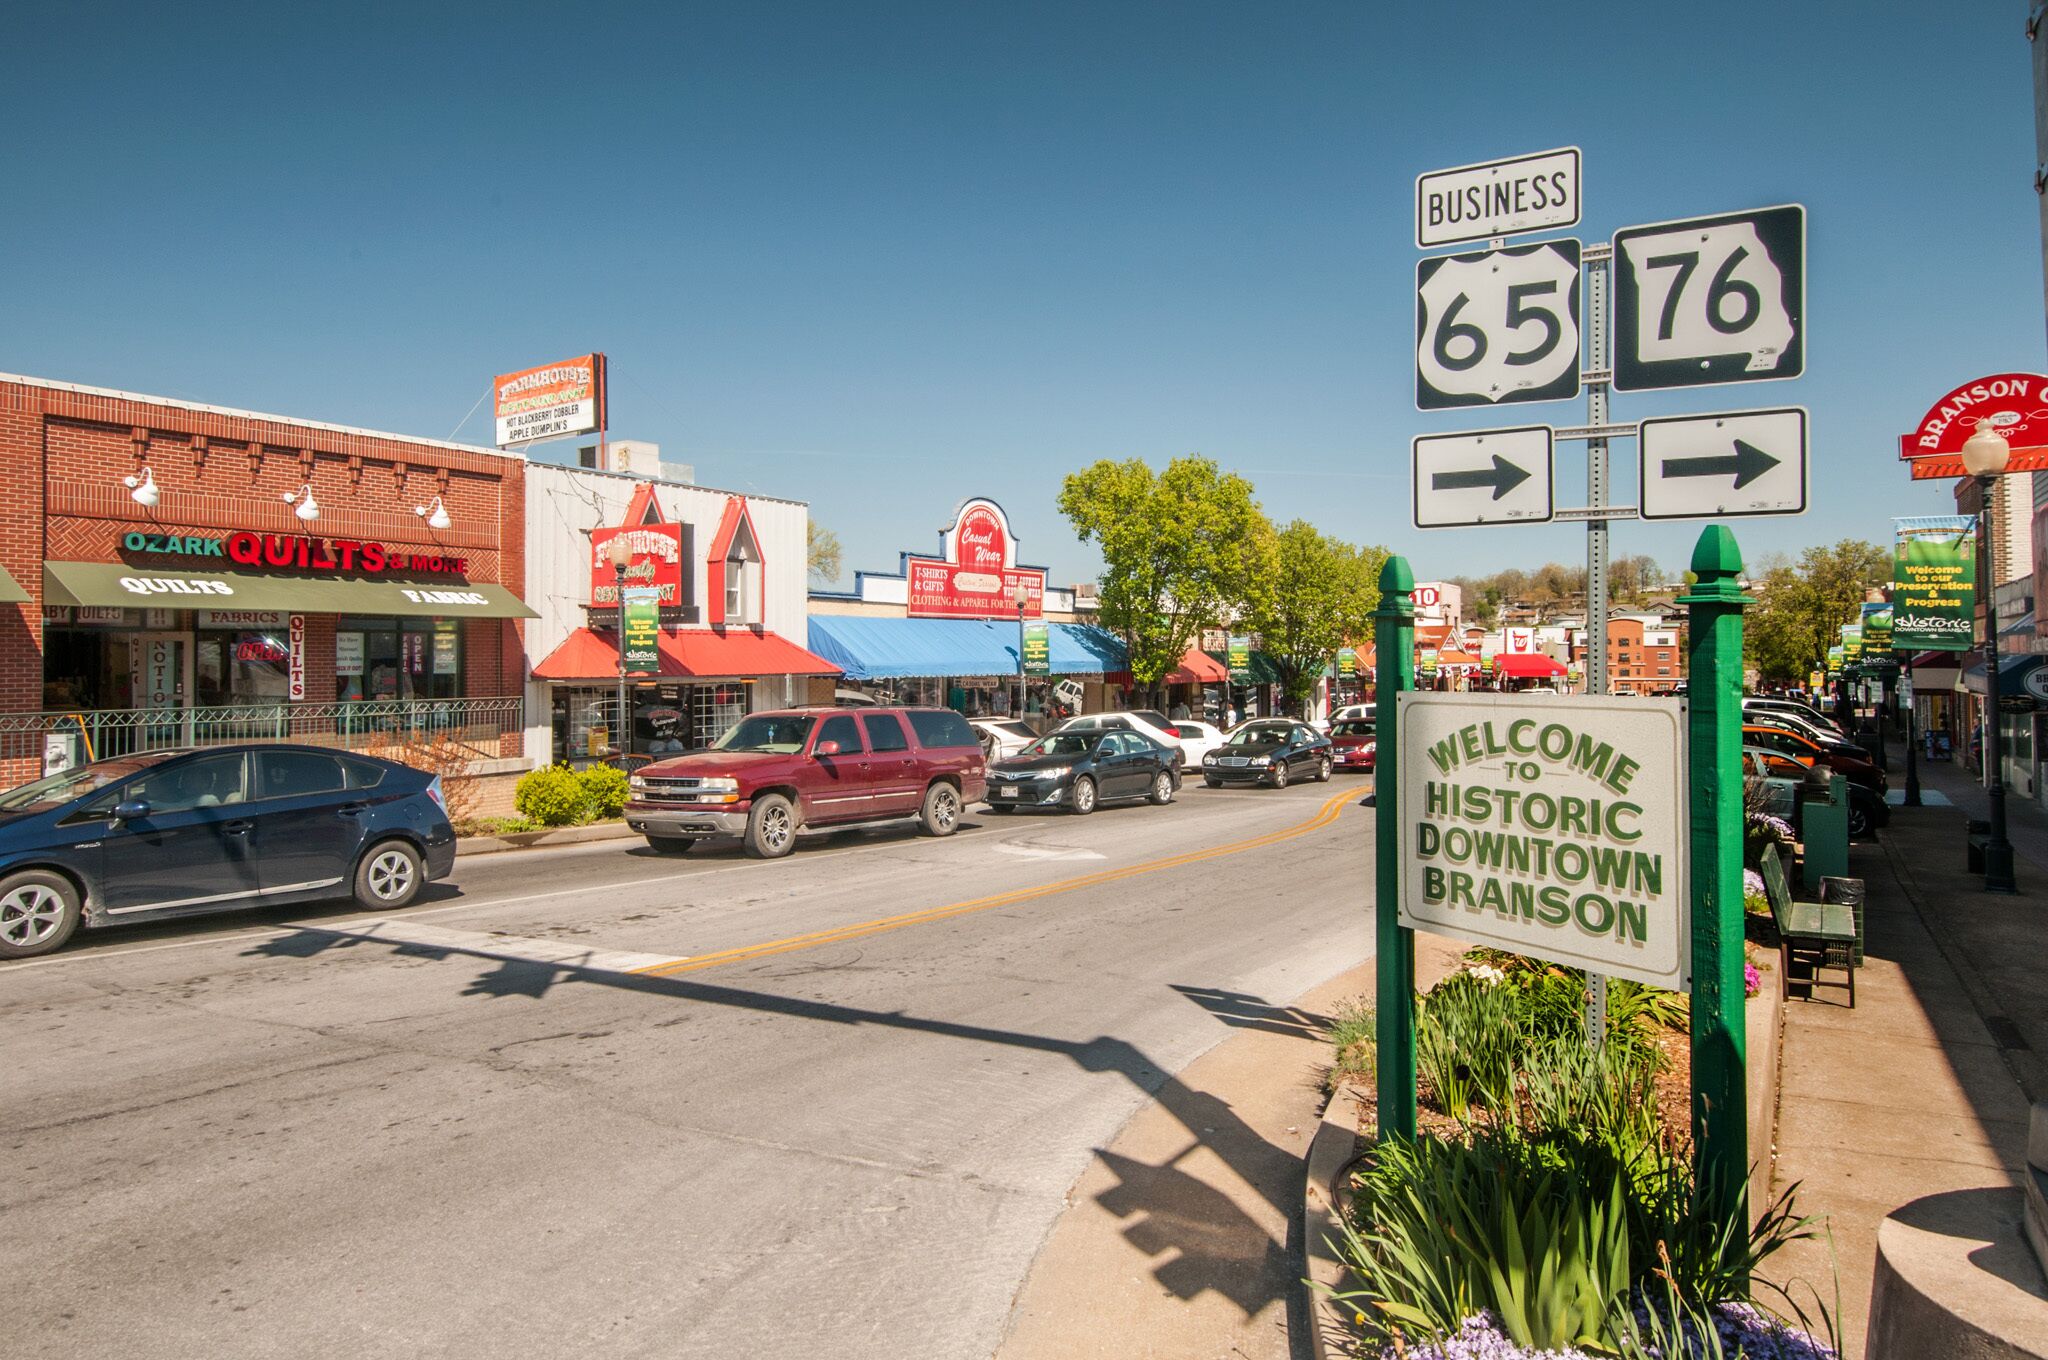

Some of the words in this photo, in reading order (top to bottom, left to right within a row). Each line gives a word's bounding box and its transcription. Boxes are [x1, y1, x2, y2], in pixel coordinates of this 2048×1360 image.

[1428, 171, 1568, 227] BUSINESS
[1645, 244, 1761, 341] 76
[1432, 279, 1562, 372] 65
[499, 366, 591, 402] FARMHOUSE
[506, 417, 517, 428] HOT
[518, 410, 553, 426] BLACKBERRY
[554, 404, 580, 418] COBBLER
[1919, 379, 2030, 449] BRANSON
[509, 427, 529, 440] APPLE
[531, 420, 568, 436] DUMPLIN'S
[965, 510, 1000, 531] DOWNTOWN
[961, 527, 993, 546] Casual
[124, 532, 223, 557] OZARK
[229, 531, 386, 572] QUILTS
[389, 552, 405, 569] &
[411, 554, 469, 575] MORE
[594, 530, 679, 568] FHOUSE
[975, 545, 1002, 562] Wear
[914, 567, 949, 580] T-SHIRTS
[1905, 565, 1964, 575] Welcome
[1914, 574, 1929, 583] to
[1930, 575, 1953, 583] our
[119, 576, 235, 596] QUILTS
[914, 580, 921, 590] &
[922, 580, 945, 592] GIFTS
[1895, 582, 1974, 591] Preservation
[1928, 589, 1939, 599] &
[911, 594, 952, 607] CLOTHING
[952, 598, 959, 607] &
[960, 598, 989, 609] APPAREL
[990, 600, 1004, 609] FOR
[1408, 588, 1435, 606] 10
[1905, 598, 1962, 608] Progress
[210, 612, 279, 624] FABRICS
[1894, 613, 1972, 629] Historic
[290, 616, 304, 696] QUILTS
[414, 635, 422, 672] OPEN
[153, 641, 167, 729] NOTIO
[1427, 718, 1641, 796] WELCOME
[1504, 760, 1542, 782] TO
[1426, 780, 1645, 843] HISTORIC
[1417, 821, 1663, 897] DOWNTOWN
[1423, 865, 1648, 944] BRANSON
